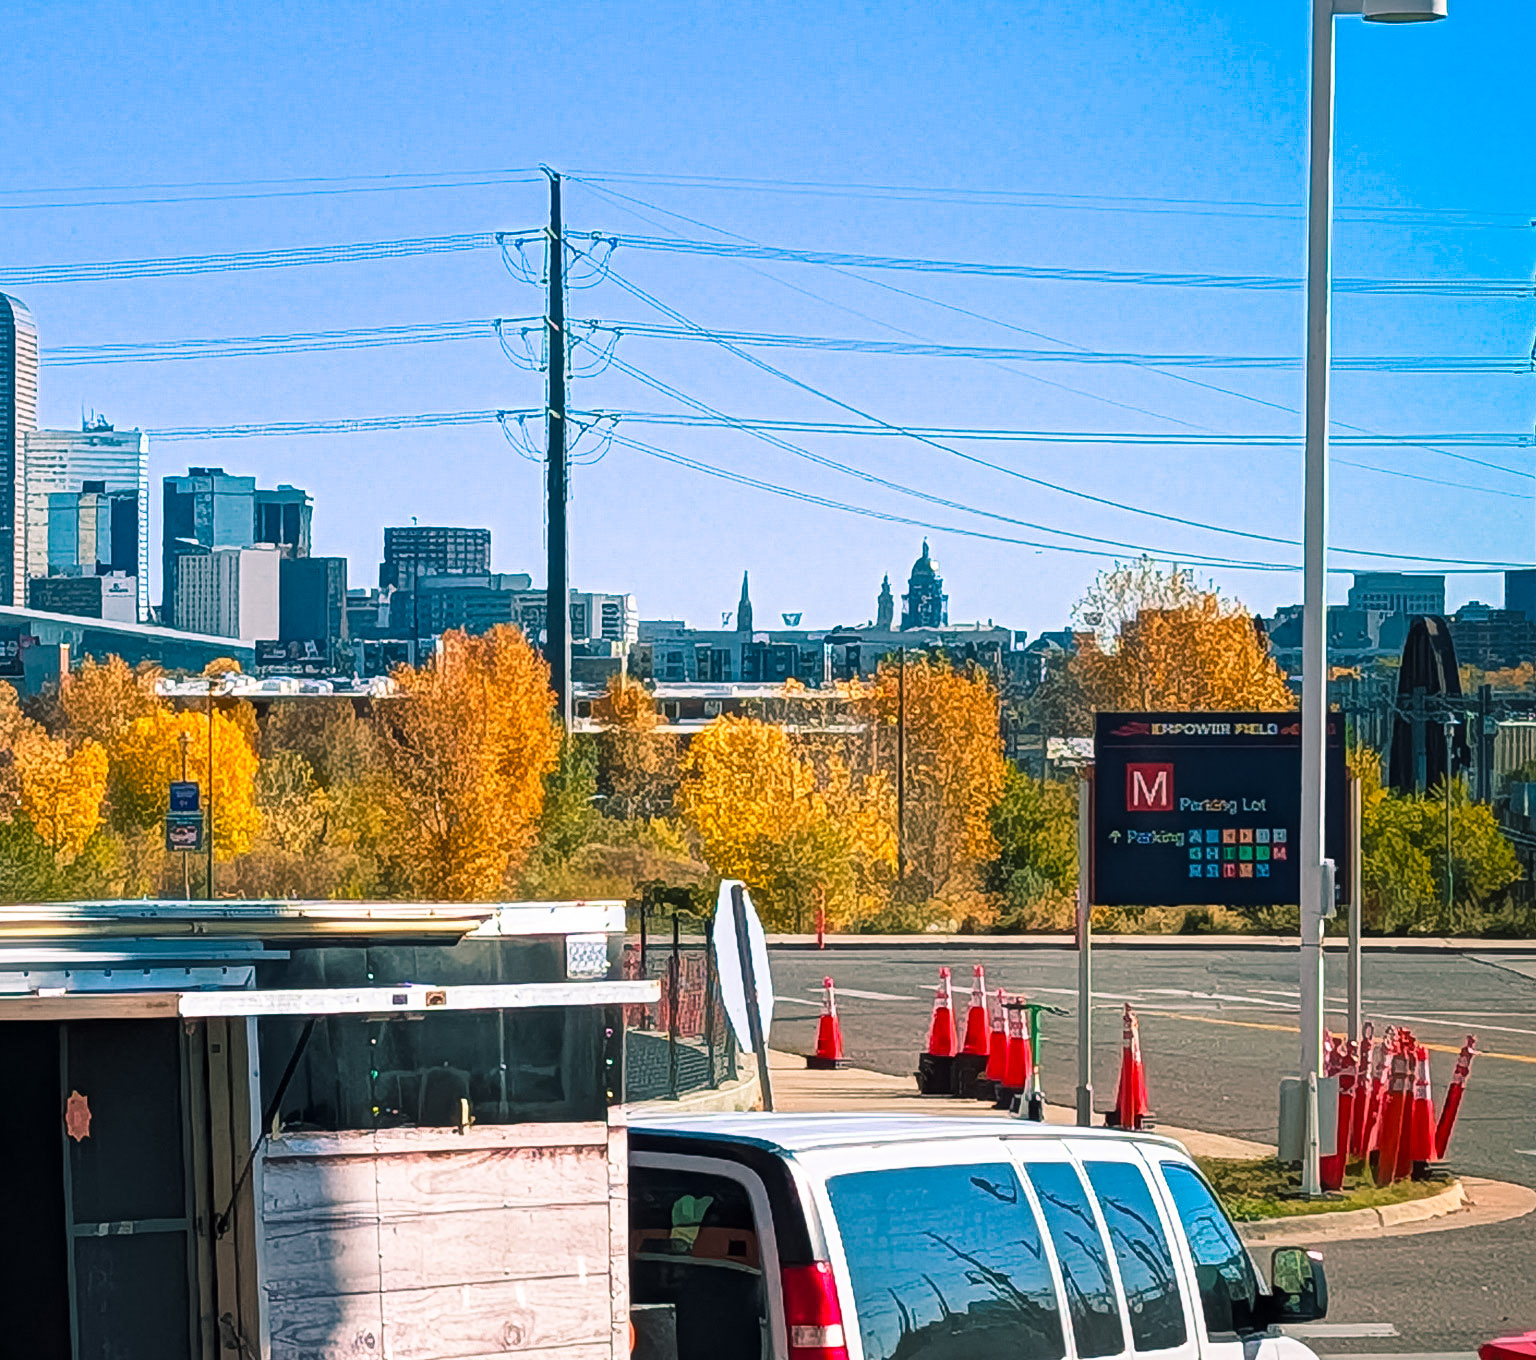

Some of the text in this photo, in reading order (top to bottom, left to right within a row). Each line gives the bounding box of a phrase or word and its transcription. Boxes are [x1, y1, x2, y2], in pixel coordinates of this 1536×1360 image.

[1132, 770, 1168, 807] M
[1179, 797, 1267, 815] Parking Lot
[1127, 829, 1185, 847] Parking
